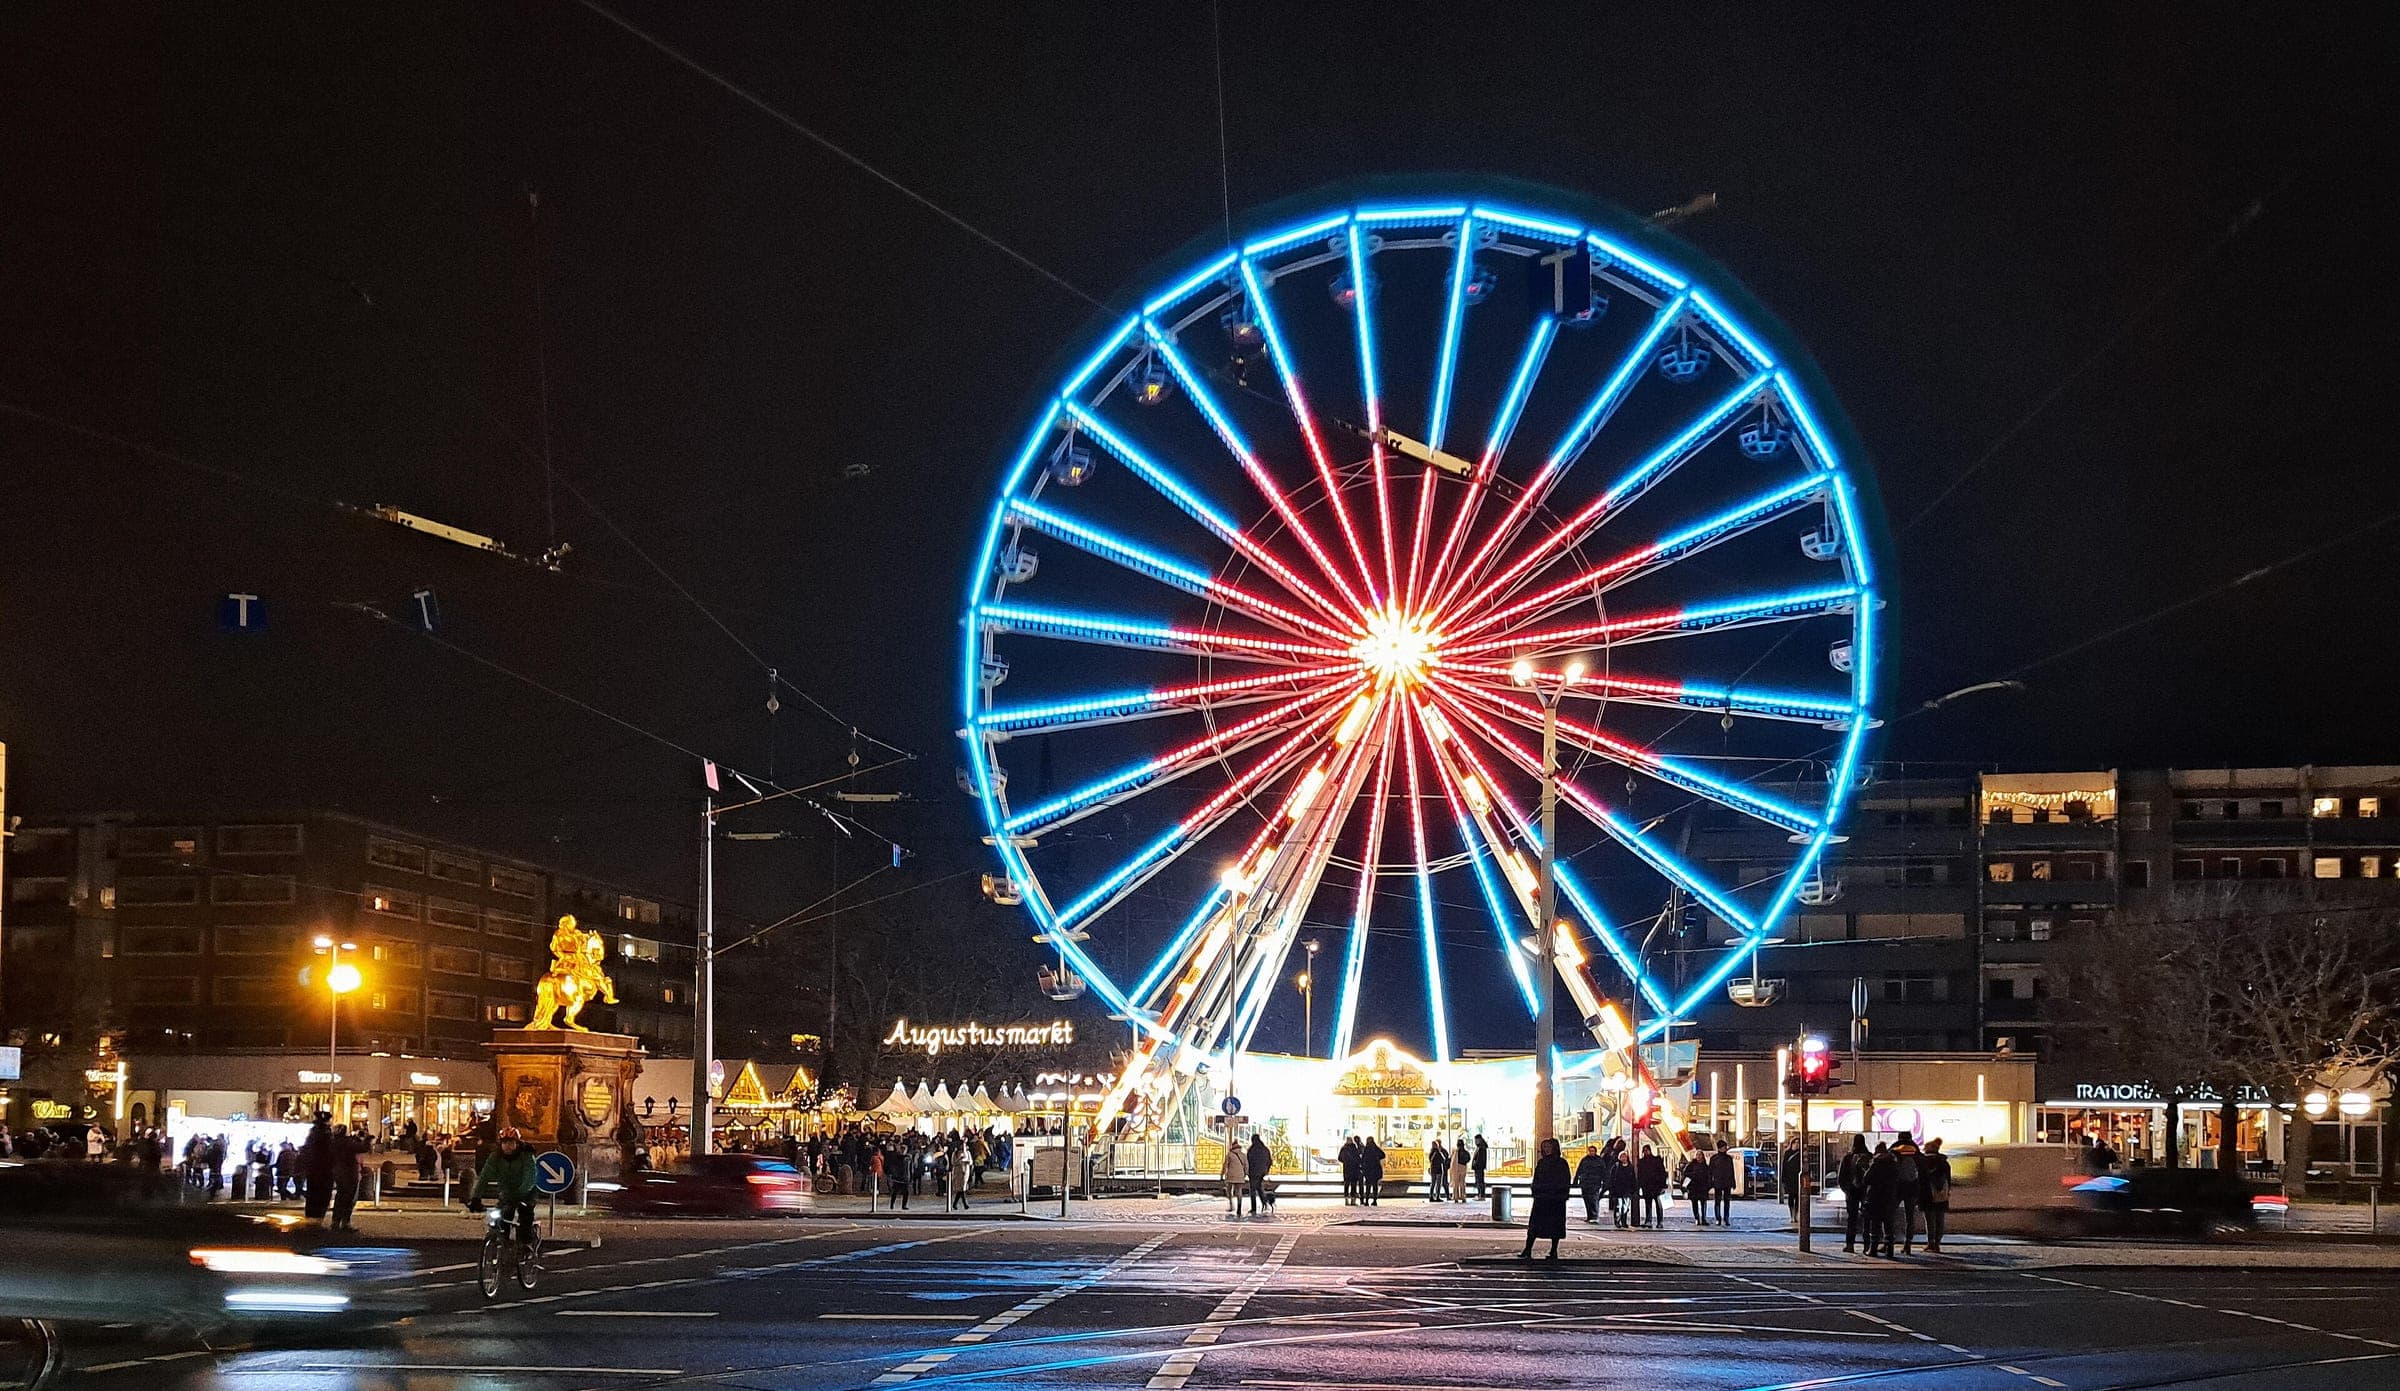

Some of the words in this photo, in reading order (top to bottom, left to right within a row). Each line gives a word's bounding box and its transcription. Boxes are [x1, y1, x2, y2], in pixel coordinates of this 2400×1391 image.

[1540, 247, 1578, 314] T
[229, 593, 258, 627] T
[414, 590, 433, 631] T
[883, 1019, 1073, 1056] Augustusmarkt
